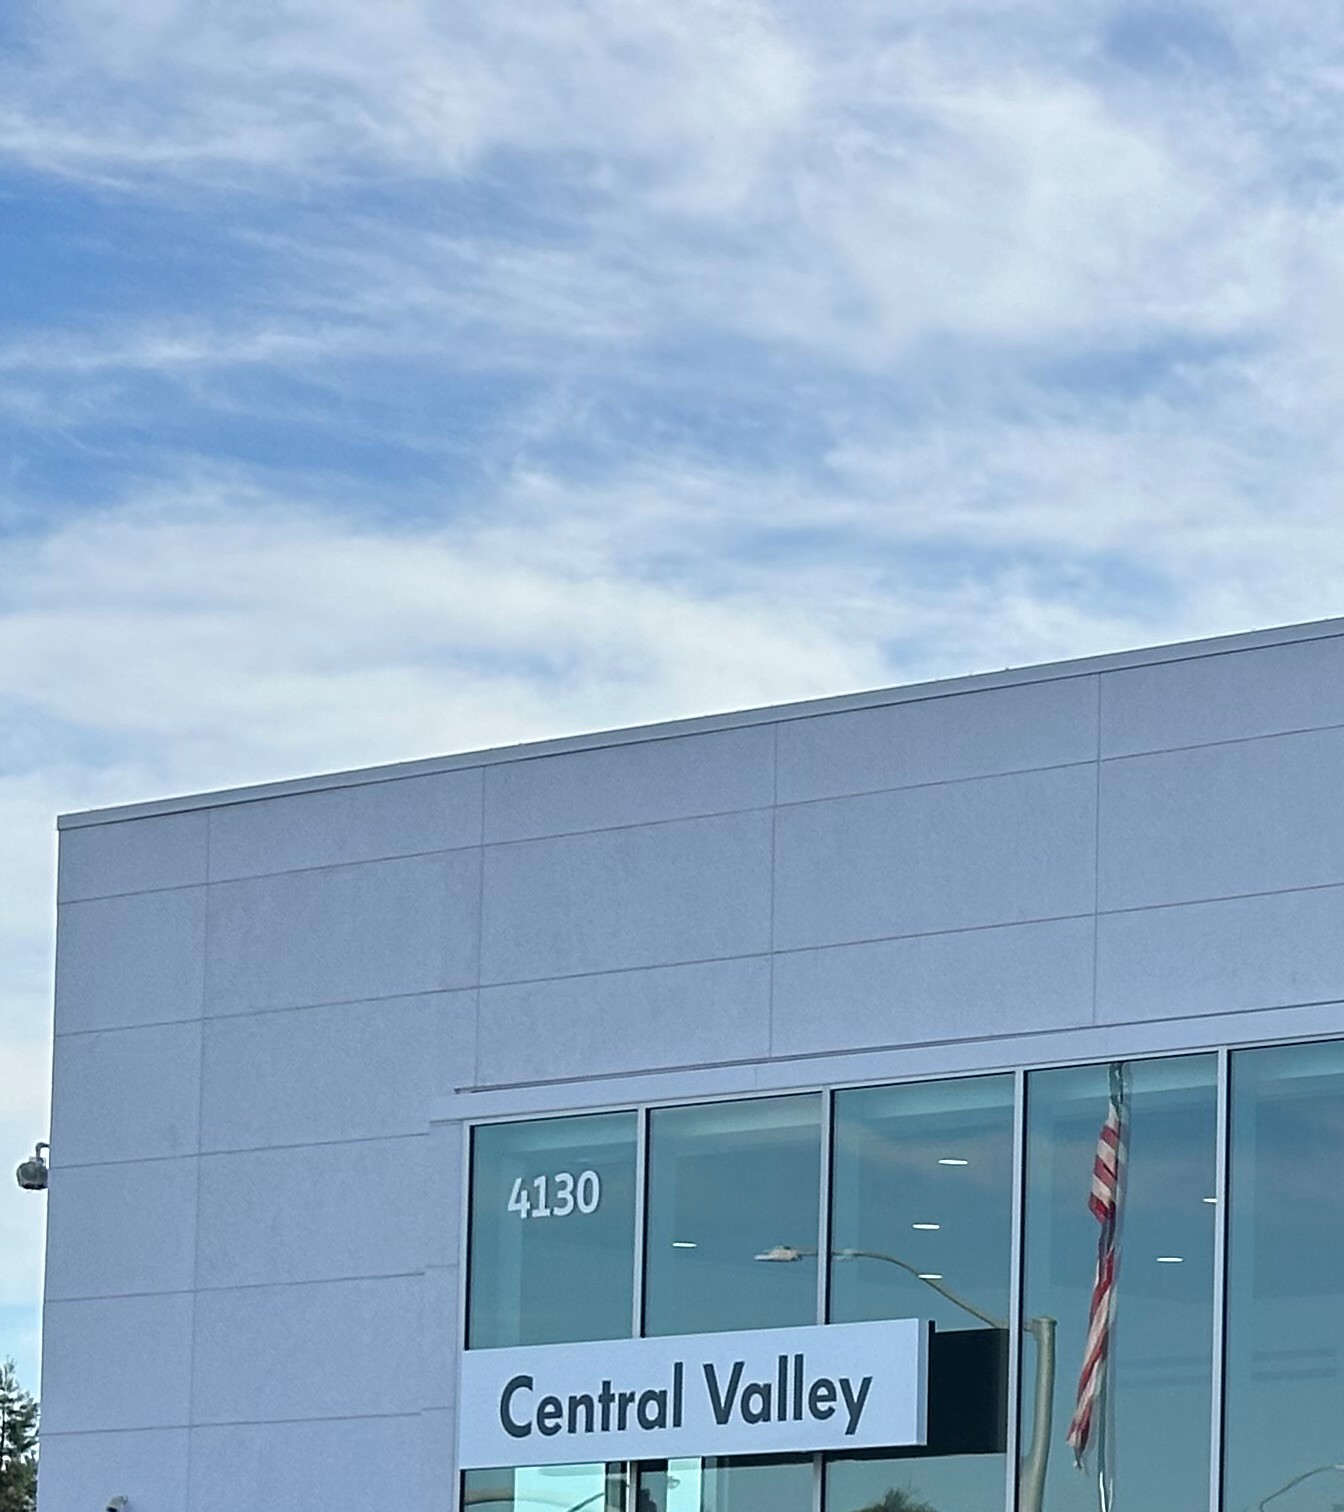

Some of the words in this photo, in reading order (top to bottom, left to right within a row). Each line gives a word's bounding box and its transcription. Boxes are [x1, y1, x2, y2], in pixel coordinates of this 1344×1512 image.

[507, 1170, 601, 1219] 4130
[499, 1361, 684, 1438] Central
[703, 1353, 873, 1435] Valley
